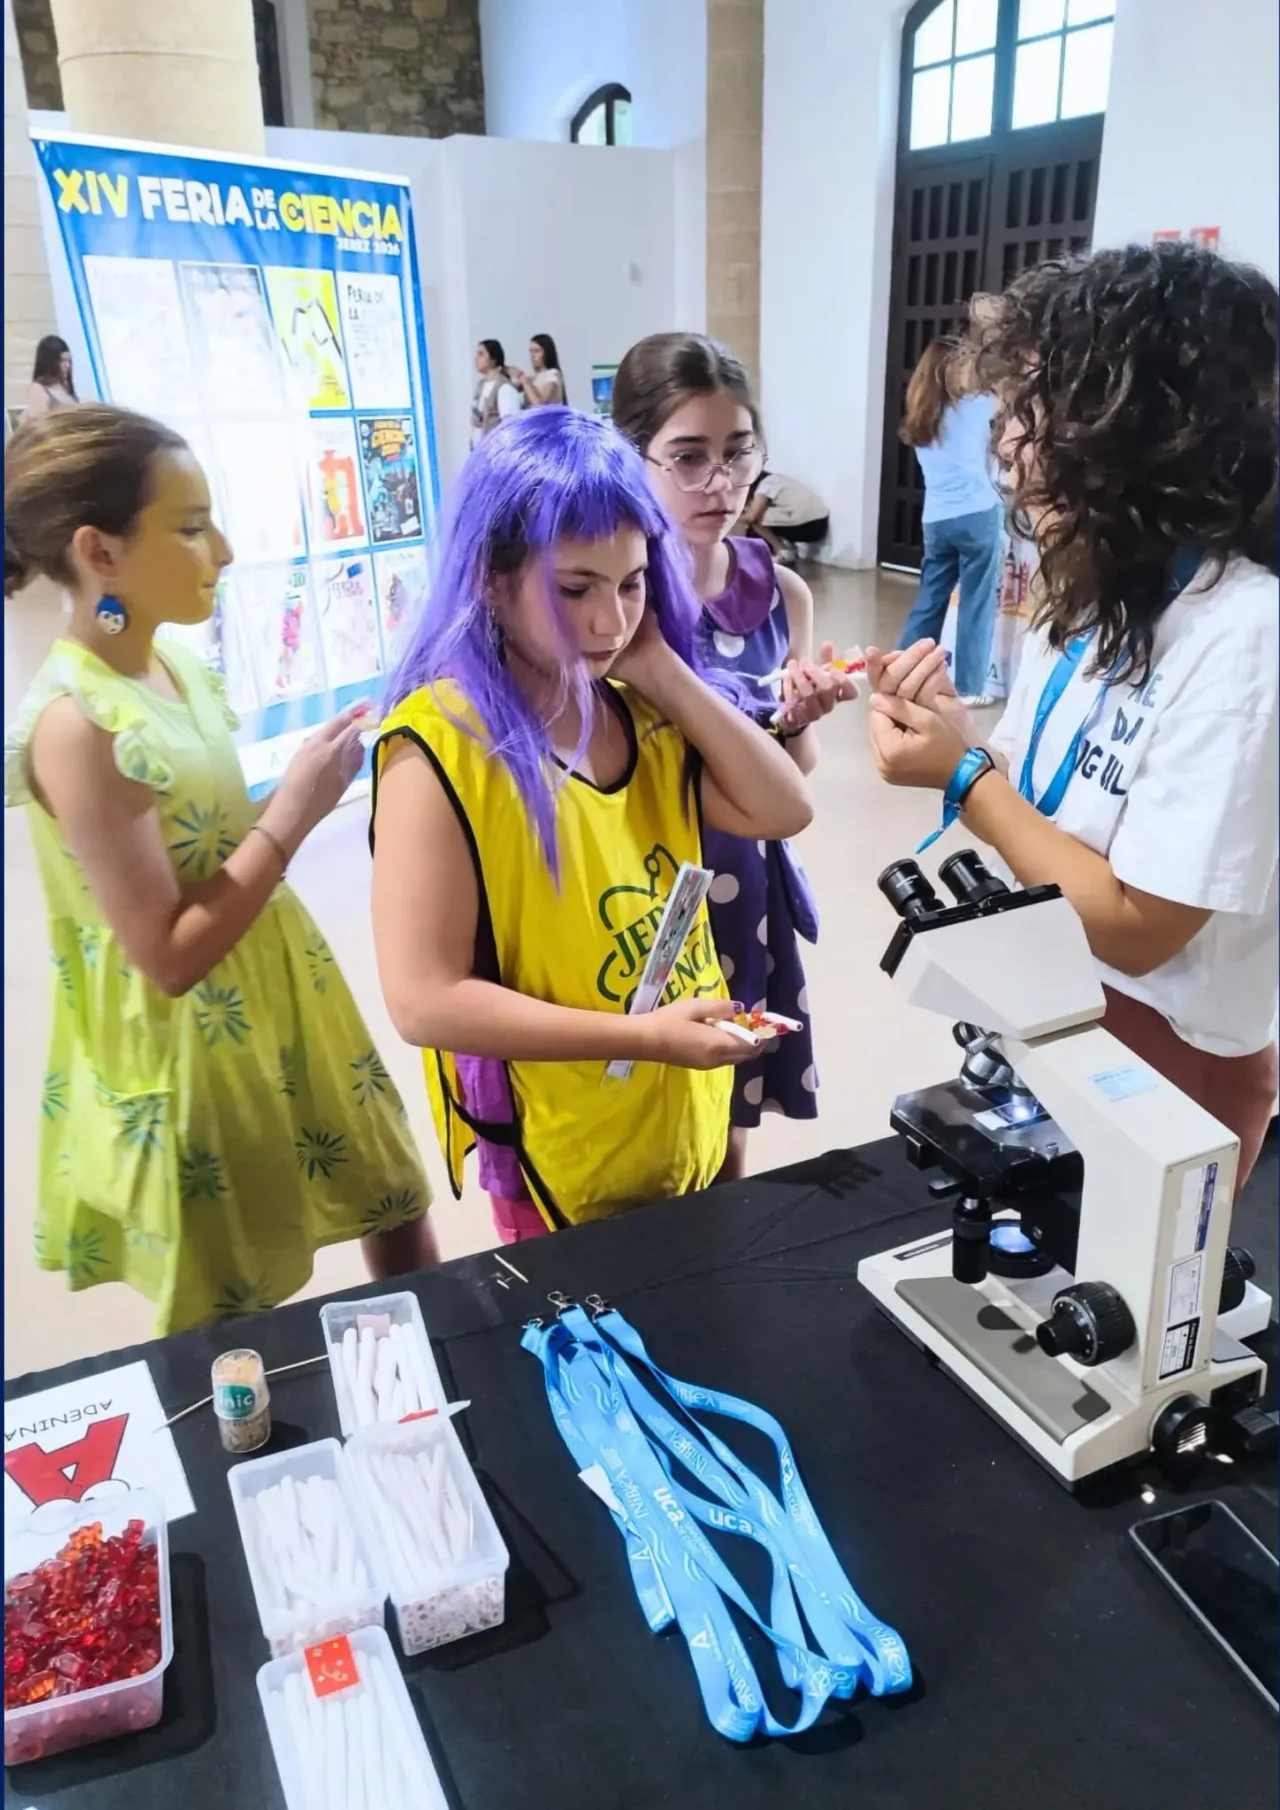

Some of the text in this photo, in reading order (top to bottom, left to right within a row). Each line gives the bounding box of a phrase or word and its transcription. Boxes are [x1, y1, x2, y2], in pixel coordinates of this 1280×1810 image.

[52, 168, 404, 242] XIV FERIA DE LA CIENCIA
[4, 1398, 113, 1442] ADENINA
[4, 1412, 130, 1507] A
[652, 1485, 686, 1523] uca
[708, 1507, 754, 1535] uca
